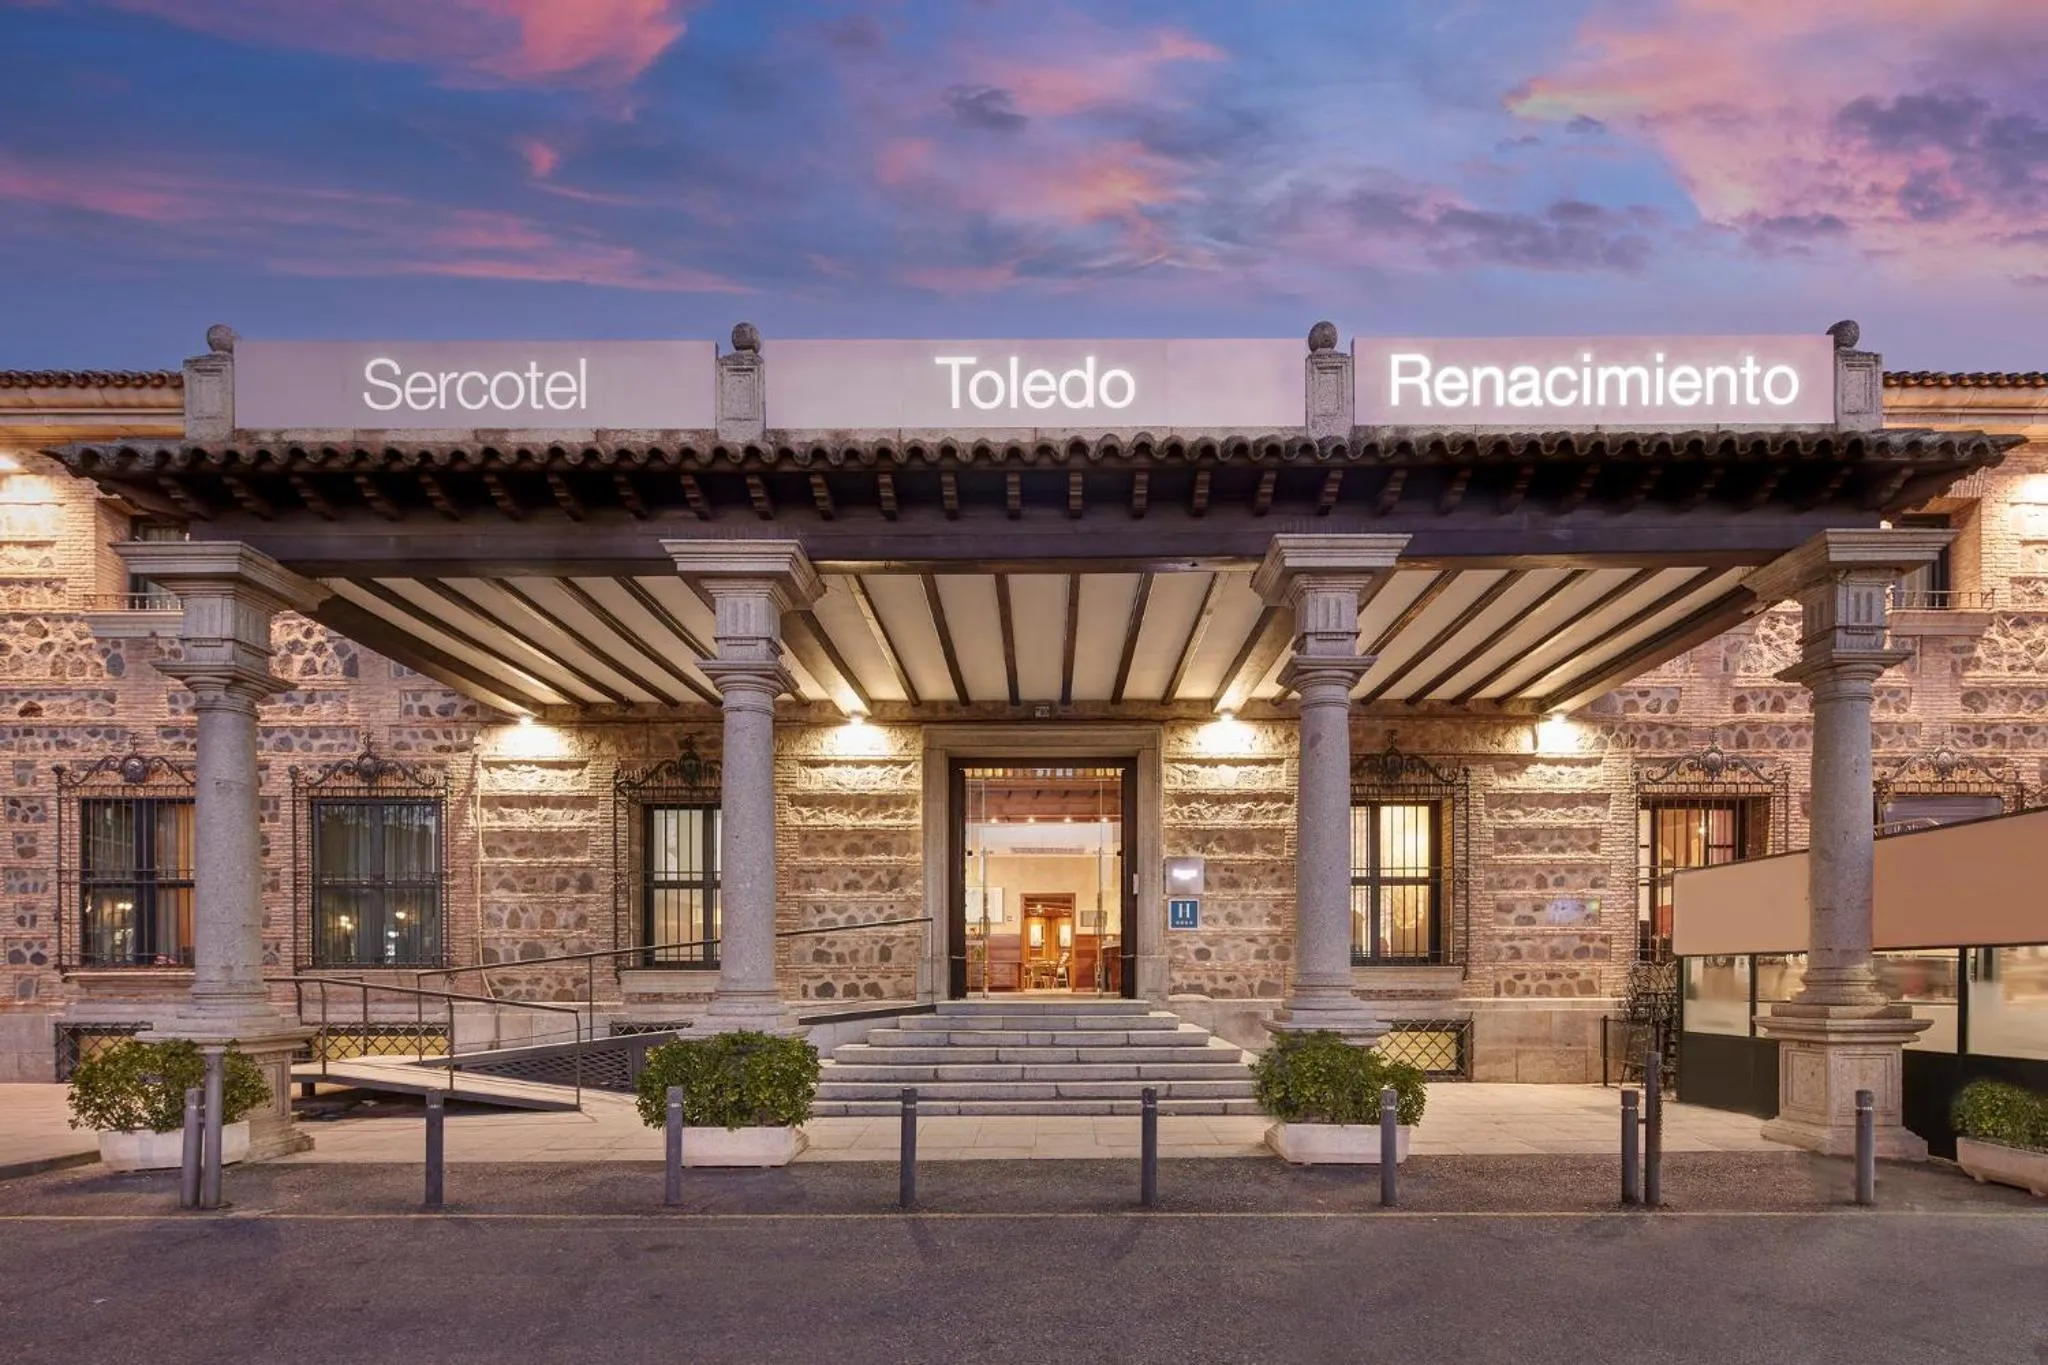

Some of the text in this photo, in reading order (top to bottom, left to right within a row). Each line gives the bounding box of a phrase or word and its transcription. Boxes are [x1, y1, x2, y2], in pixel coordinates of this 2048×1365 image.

[363, 353, 1800, 411] Sercotel Toledo Renacimiento
[1178, 903, 1191, 919] H
